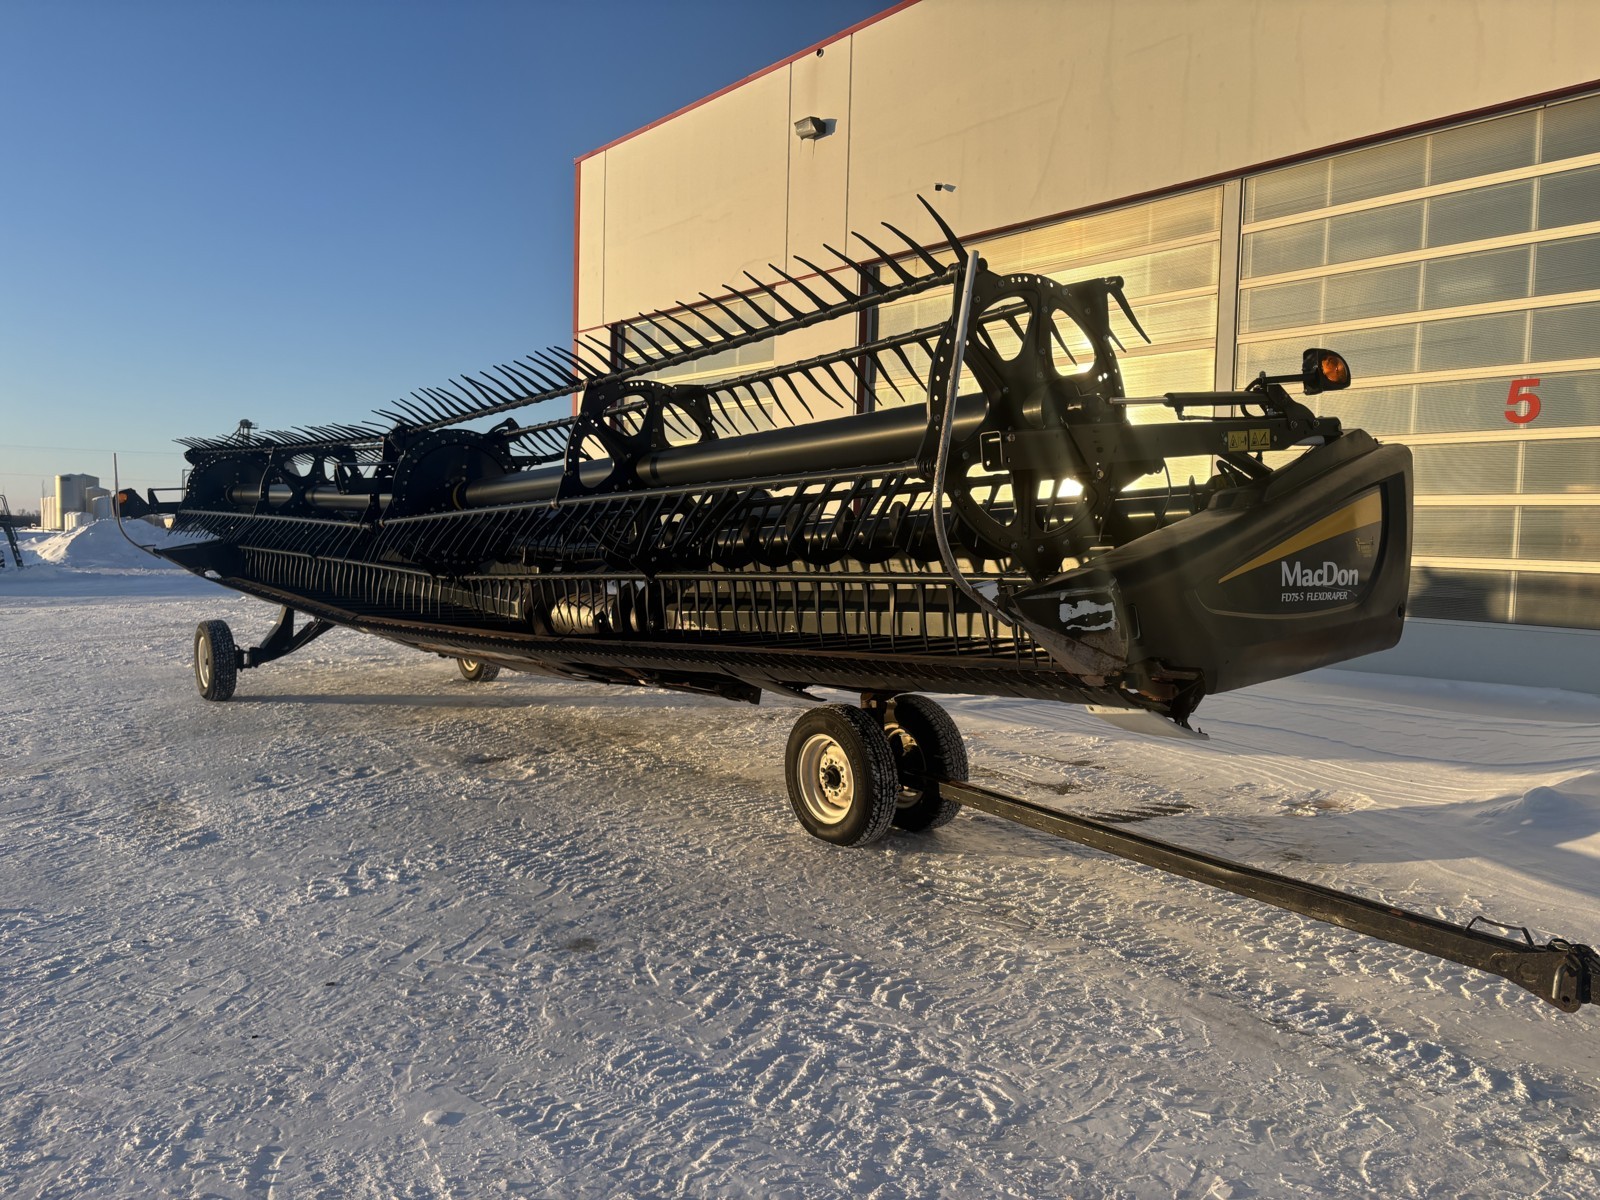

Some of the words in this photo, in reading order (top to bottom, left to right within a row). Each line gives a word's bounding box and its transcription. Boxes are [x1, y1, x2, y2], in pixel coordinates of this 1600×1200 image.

[1504, 378, 1541, 424] 5
[1281, 561, 1359, 587] MacDon
[1306, 591, 1348, 601] FLEXDRAPER
